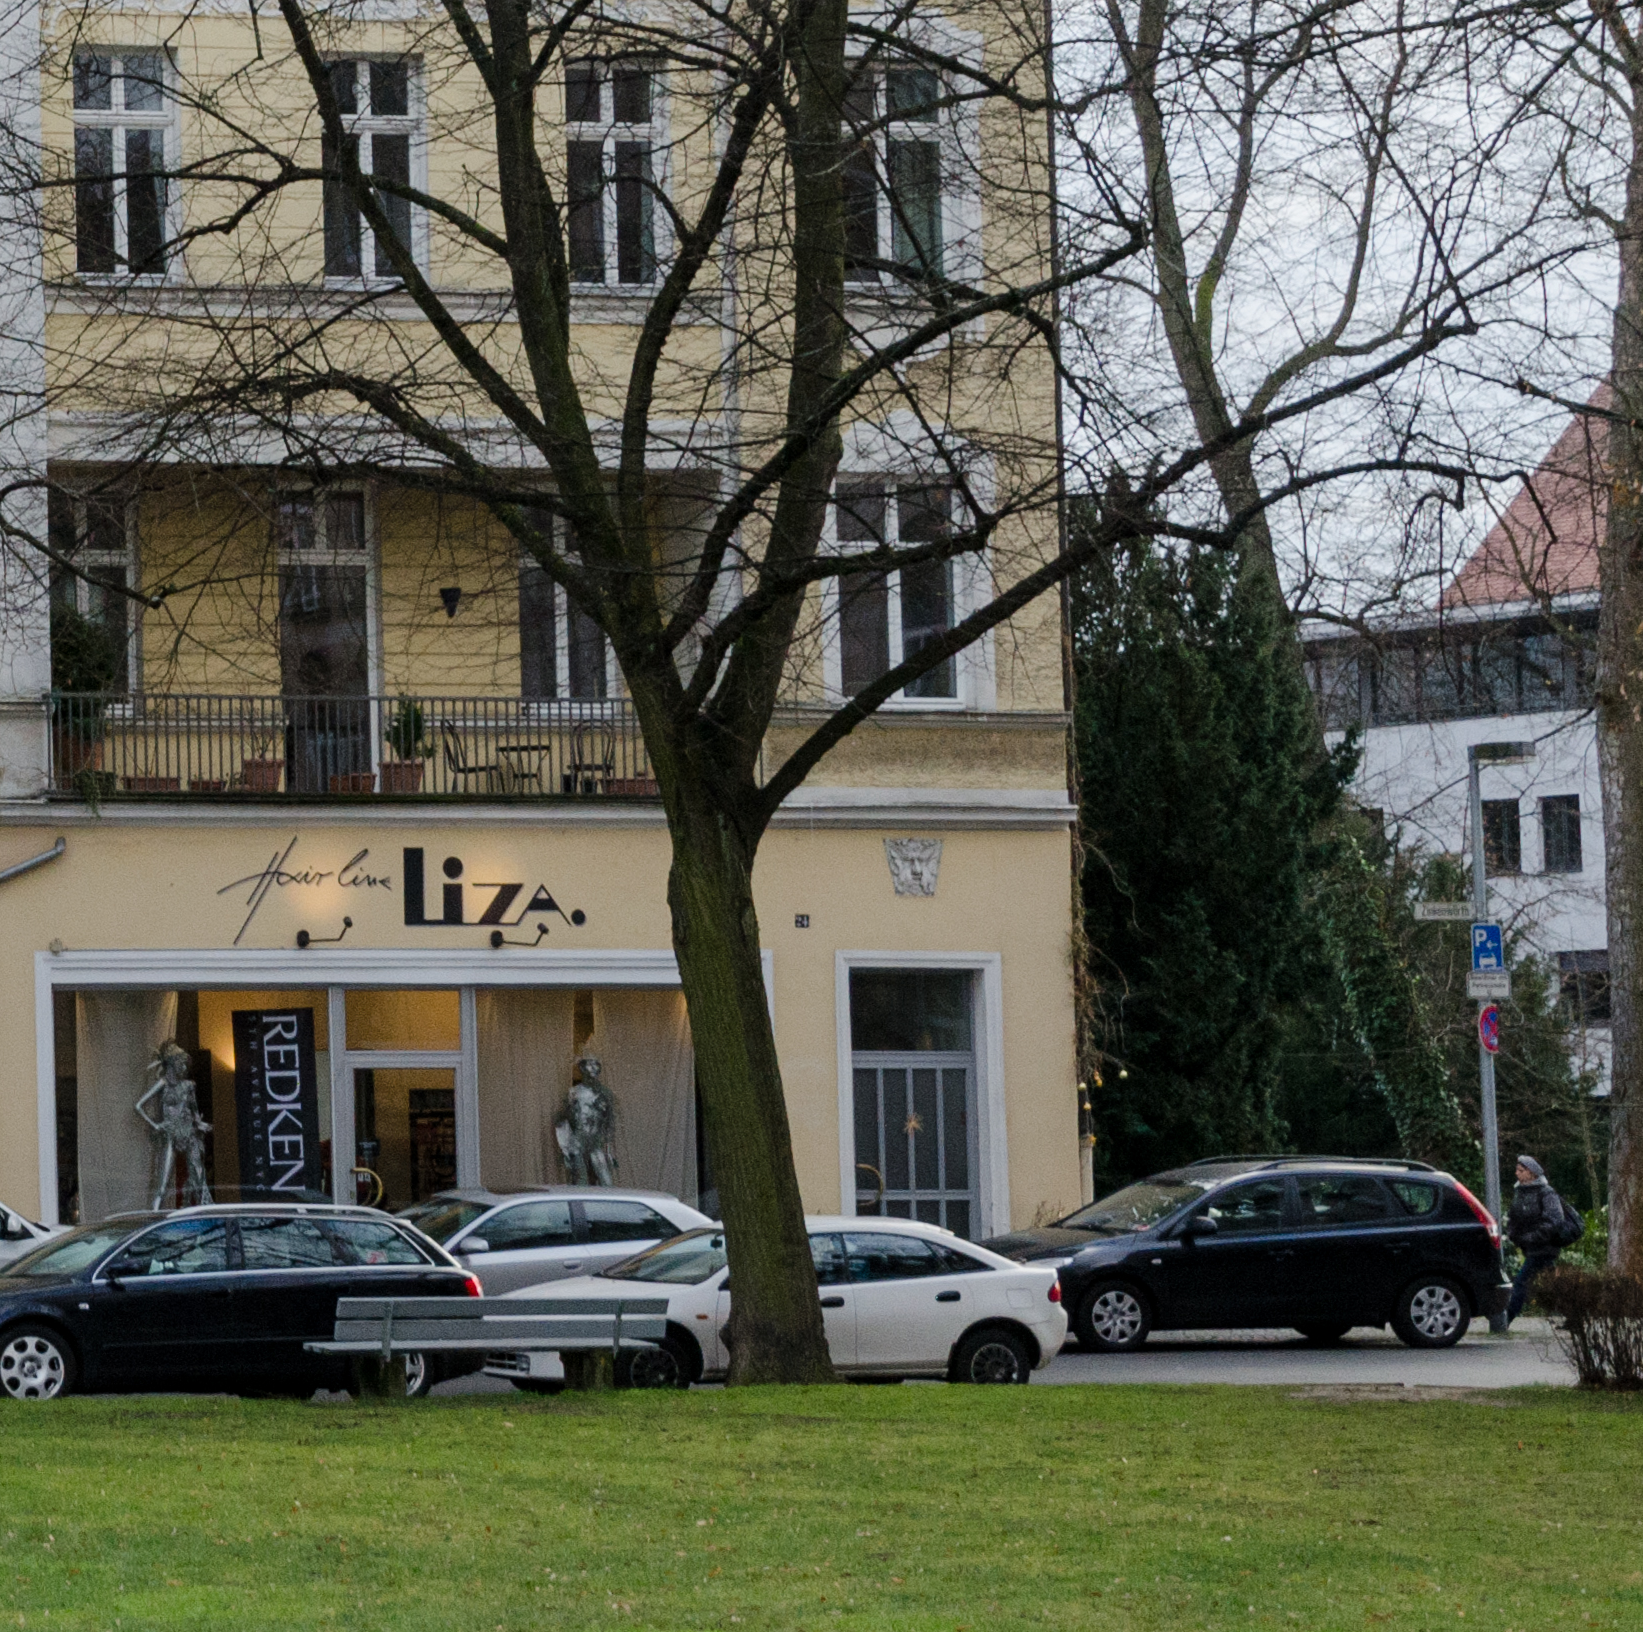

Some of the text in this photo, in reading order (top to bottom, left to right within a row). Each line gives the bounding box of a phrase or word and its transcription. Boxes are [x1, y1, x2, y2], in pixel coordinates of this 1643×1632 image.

[1474, 929, 1487, 947] P
[251, 1065, 263, 1141] AVENUE
[263, 1015, 306, 1191] REDKEN
[255, 1156, 265, 1191] NYC
